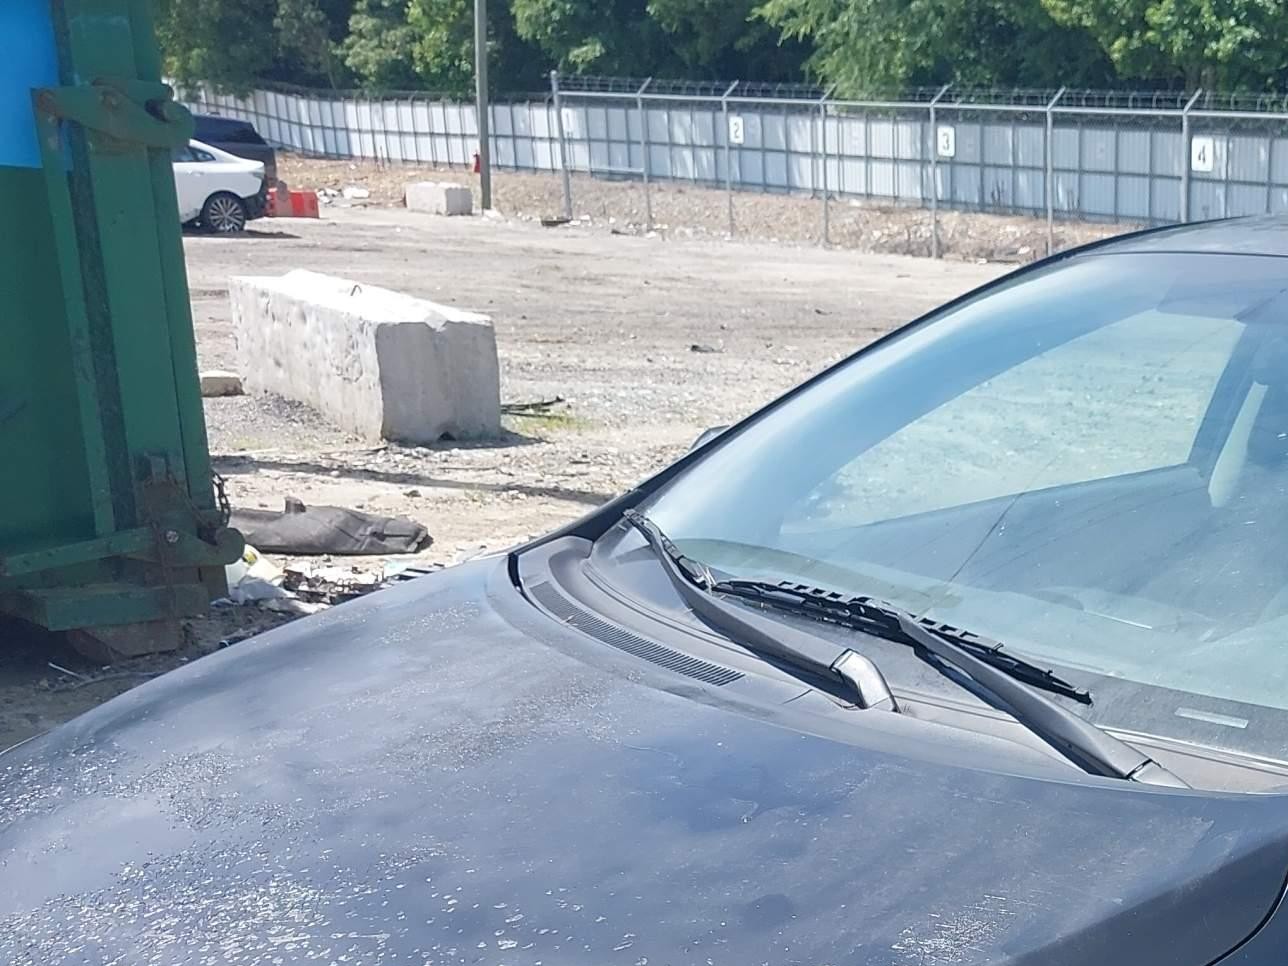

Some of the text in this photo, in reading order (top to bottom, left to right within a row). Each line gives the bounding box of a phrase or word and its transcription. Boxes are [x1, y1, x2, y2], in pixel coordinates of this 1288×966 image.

[734, 122, 740, 139] 2
[942, 132, 950, 151] 3
[1197, 144, 1206, 164] 4
